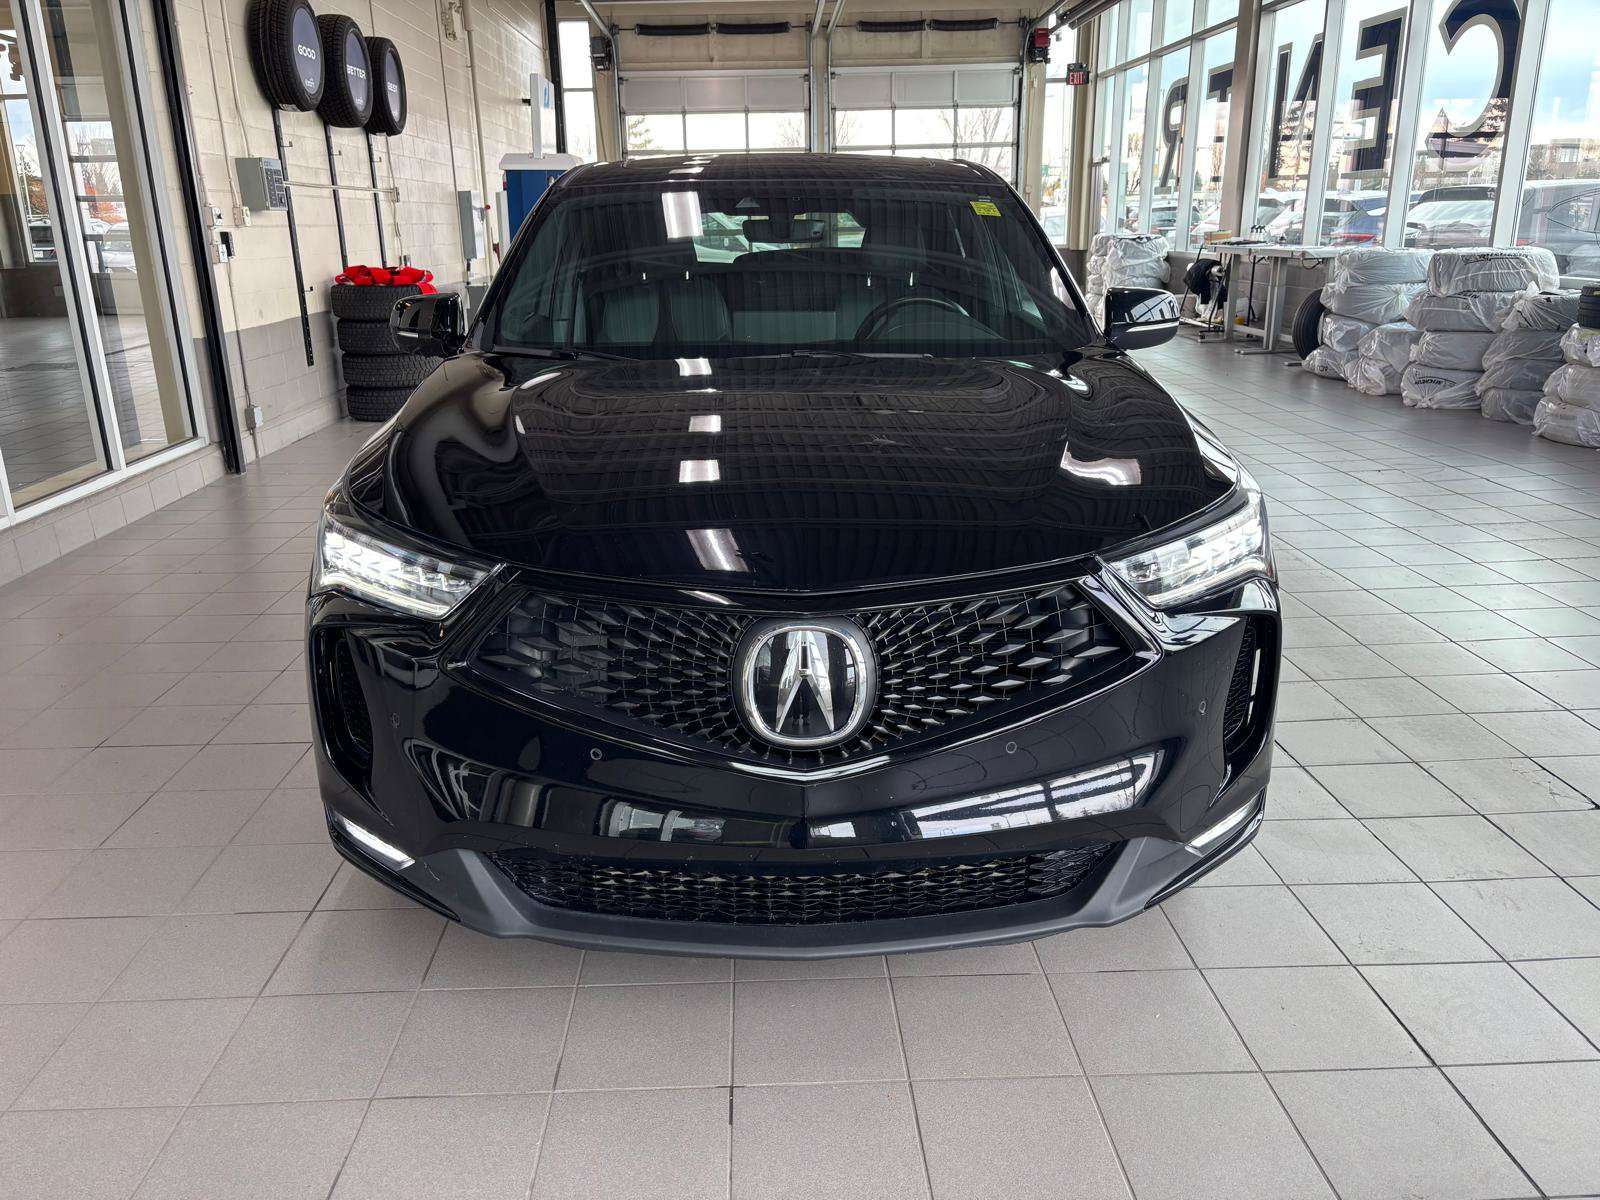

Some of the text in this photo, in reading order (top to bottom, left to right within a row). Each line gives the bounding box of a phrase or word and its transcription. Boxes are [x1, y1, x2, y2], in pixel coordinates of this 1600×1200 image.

[297, 44, 316, 60] GOOD
[346, 64, 366, 79] BETTER
[1069, 71, 1084, 85] EXIT
